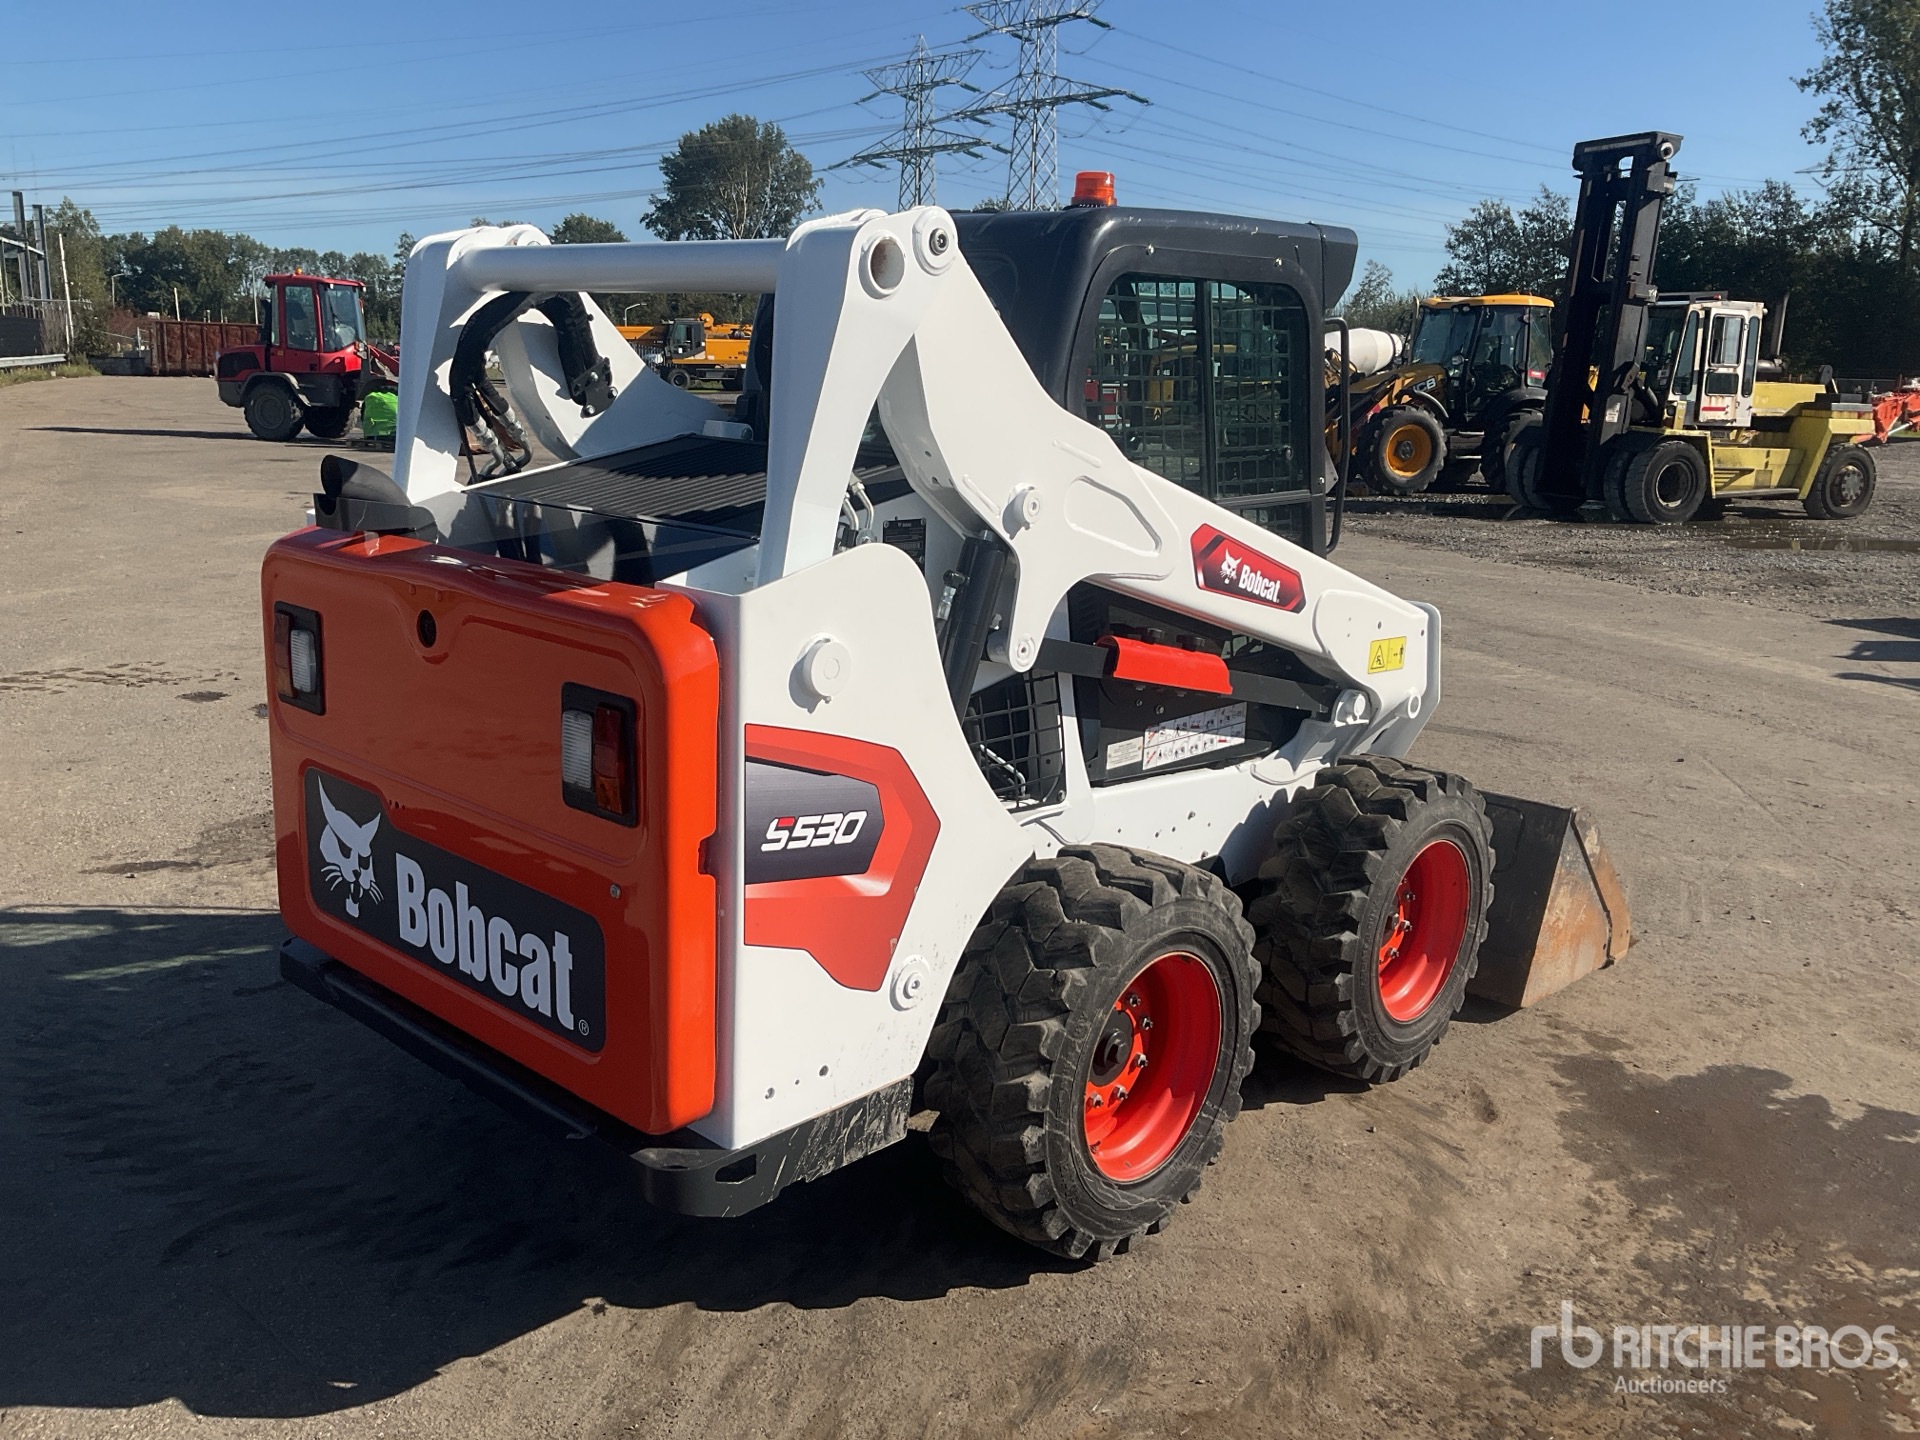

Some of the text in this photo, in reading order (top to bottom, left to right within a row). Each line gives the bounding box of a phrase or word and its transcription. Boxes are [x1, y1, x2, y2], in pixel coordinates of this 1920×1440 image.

[1238, 564, 1281, 603] Bobcat
[761, 811, 868, 852] S530
[395, 852, 574, 1031] Bobcat
